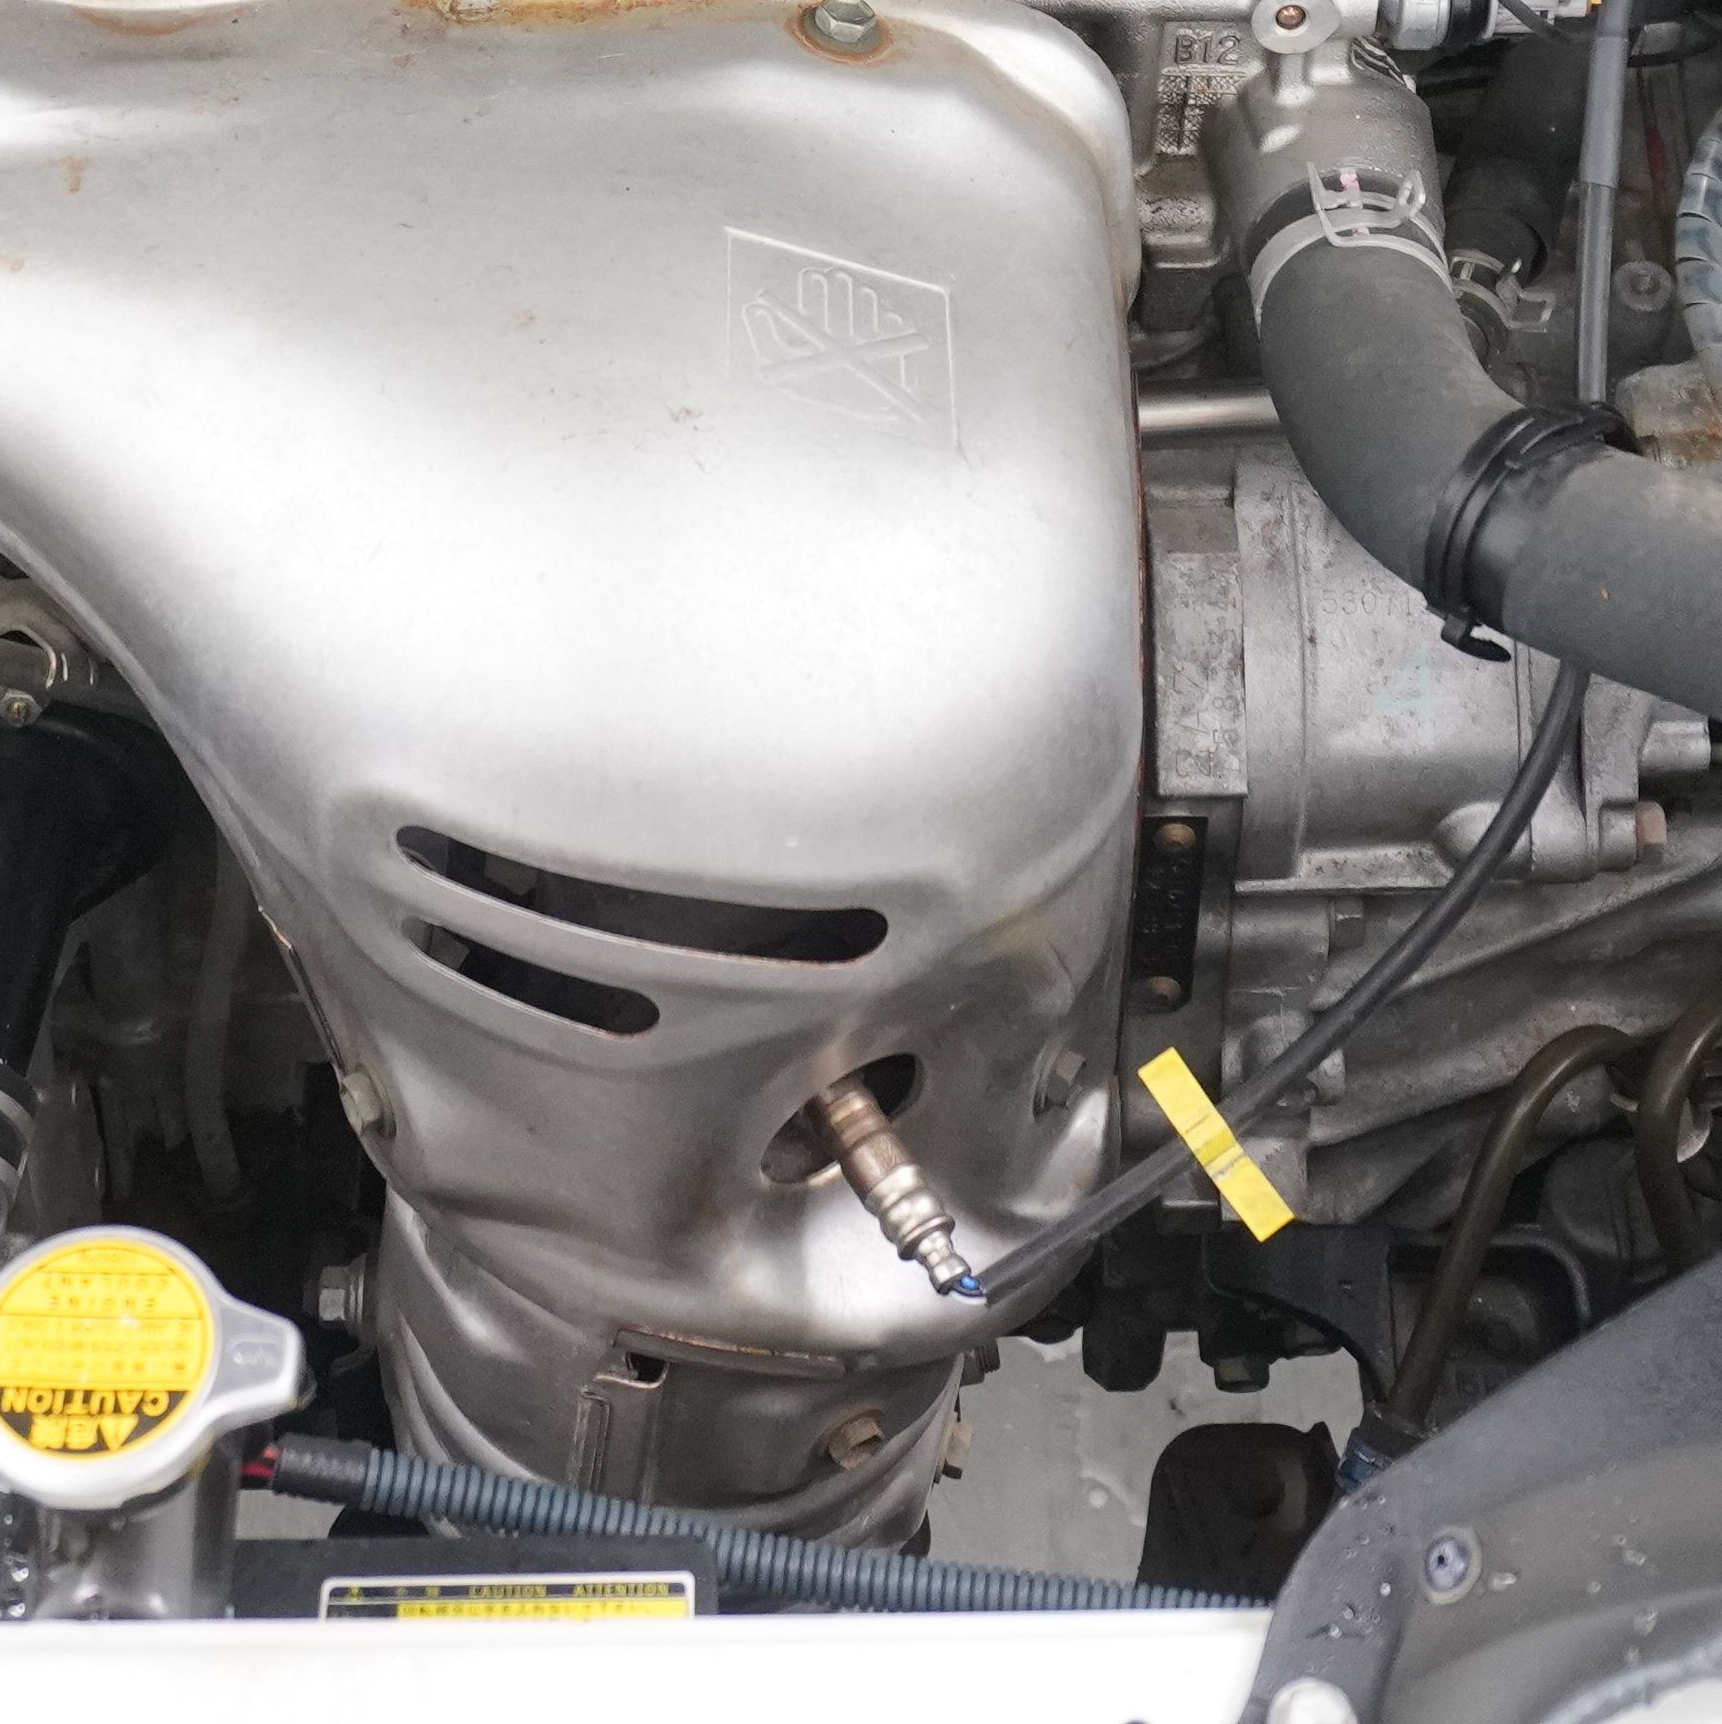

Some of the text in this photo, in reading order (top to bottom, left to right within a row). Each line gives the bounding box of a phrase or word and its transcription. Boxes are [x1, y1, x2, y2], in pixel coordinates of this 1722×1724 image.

[1175, 33, 1241, 66] B12
[48, 1294, 157, 1312] ENGINE
[1, 1388, 171, 1417] CAUTION
